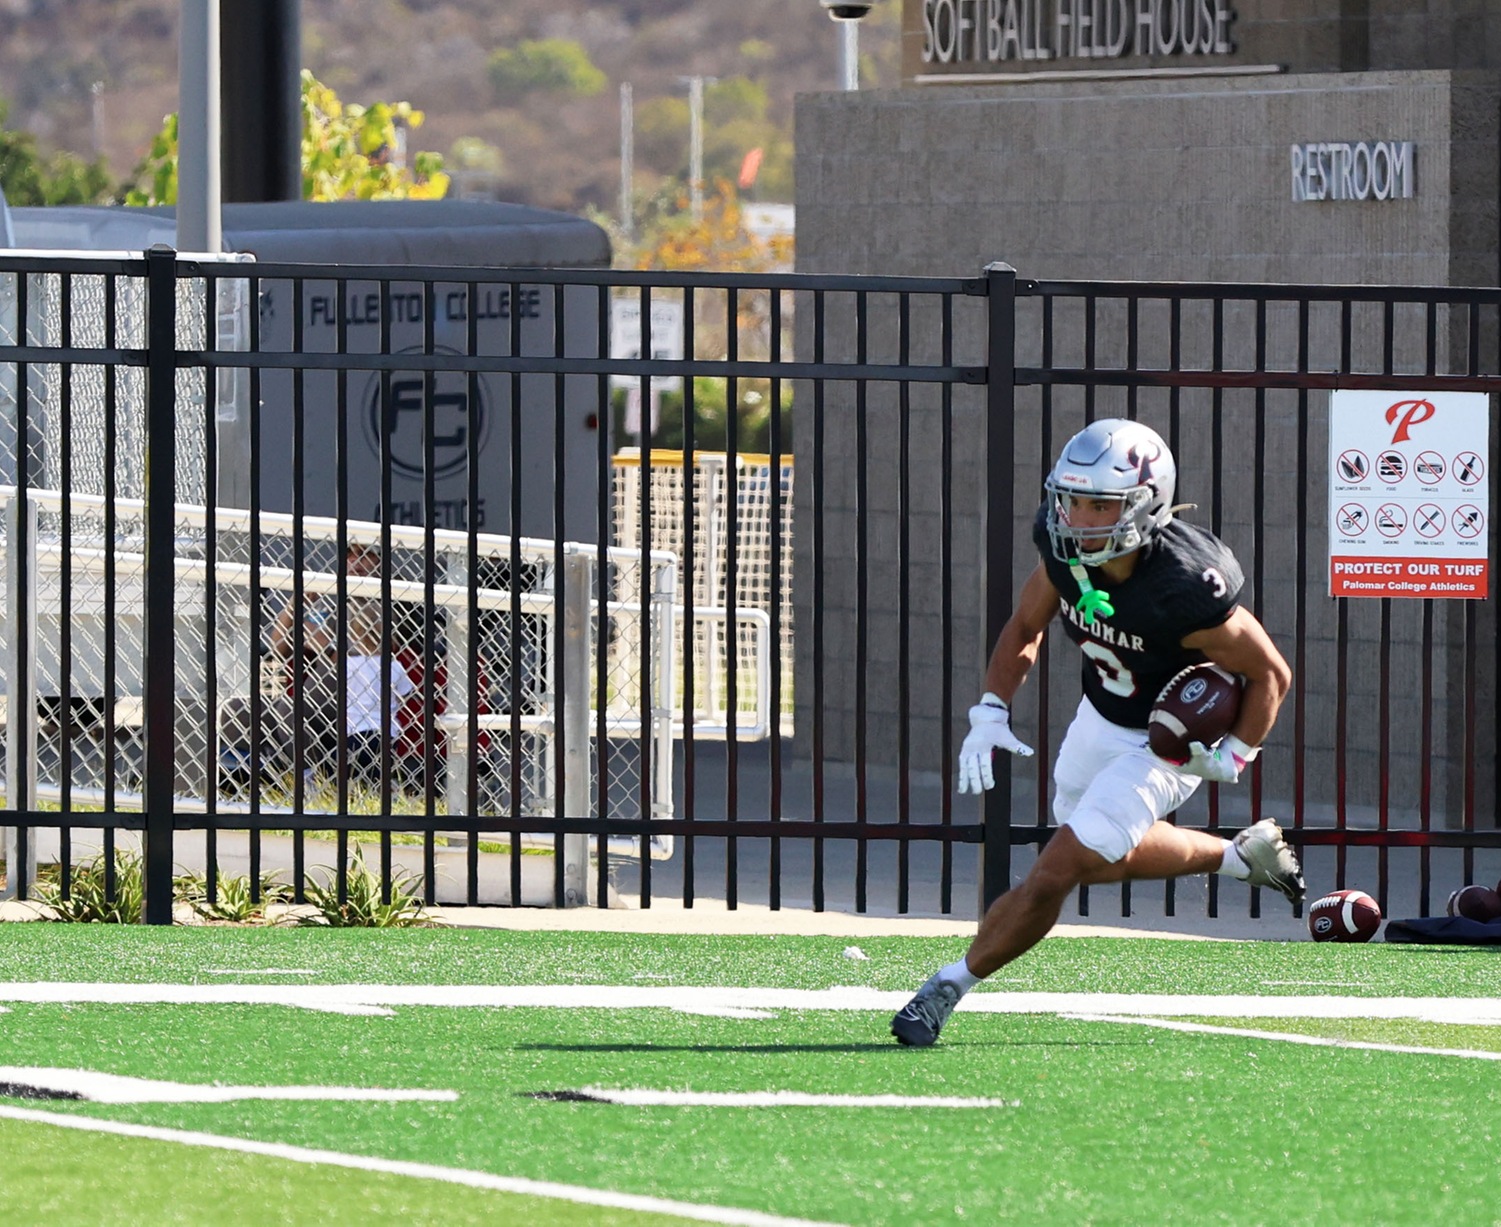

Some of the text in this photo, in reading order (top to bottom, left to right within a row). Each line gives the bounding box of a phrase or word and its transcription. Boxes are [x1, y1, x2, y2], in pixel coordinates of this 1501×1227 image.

[921, 0, 1233, 62] SOFTBALL FIELD HOUSE
[1290, 141, 1414, 201] RESTROOM
[311, 292, 436, 325] FULLETO
[1385, 398, 1436, 445] P
[1202, 567, 1227, 598] 3
[1334, 562, 1484, 576] PROTECT OUR TURF
[1343, 580, 1475, 592] Palomar College Athletics
[1060, 596, 1145, 652] PALOMAR
[1080, 638, 1138, 699] 3
